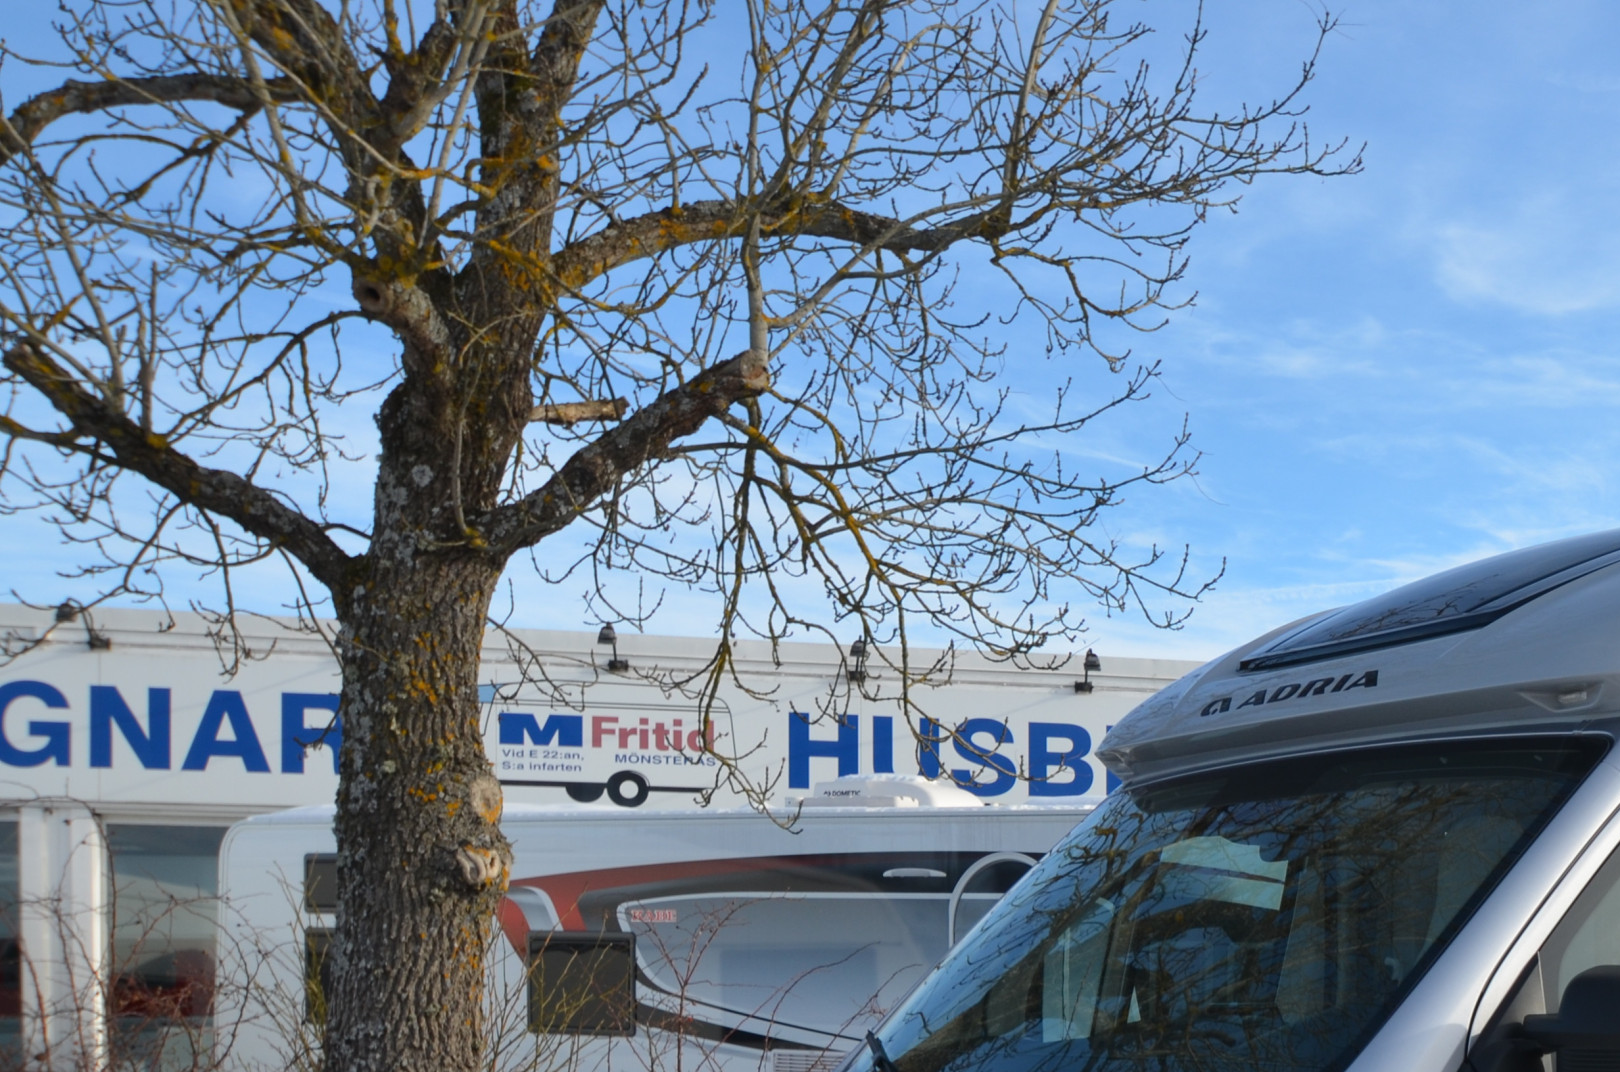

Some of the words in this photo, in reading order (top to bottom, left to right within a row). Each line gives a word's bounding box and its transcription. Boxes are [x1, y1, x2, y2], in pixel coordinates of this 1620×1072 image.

[1236, 669, 1379, 710] ADRIA
[591, 715, 714, 753] Fritid
[502, 748, 525, 758] Vid
[529, 749, 538, 759] E
[529, 762, 582, 772] infarten
